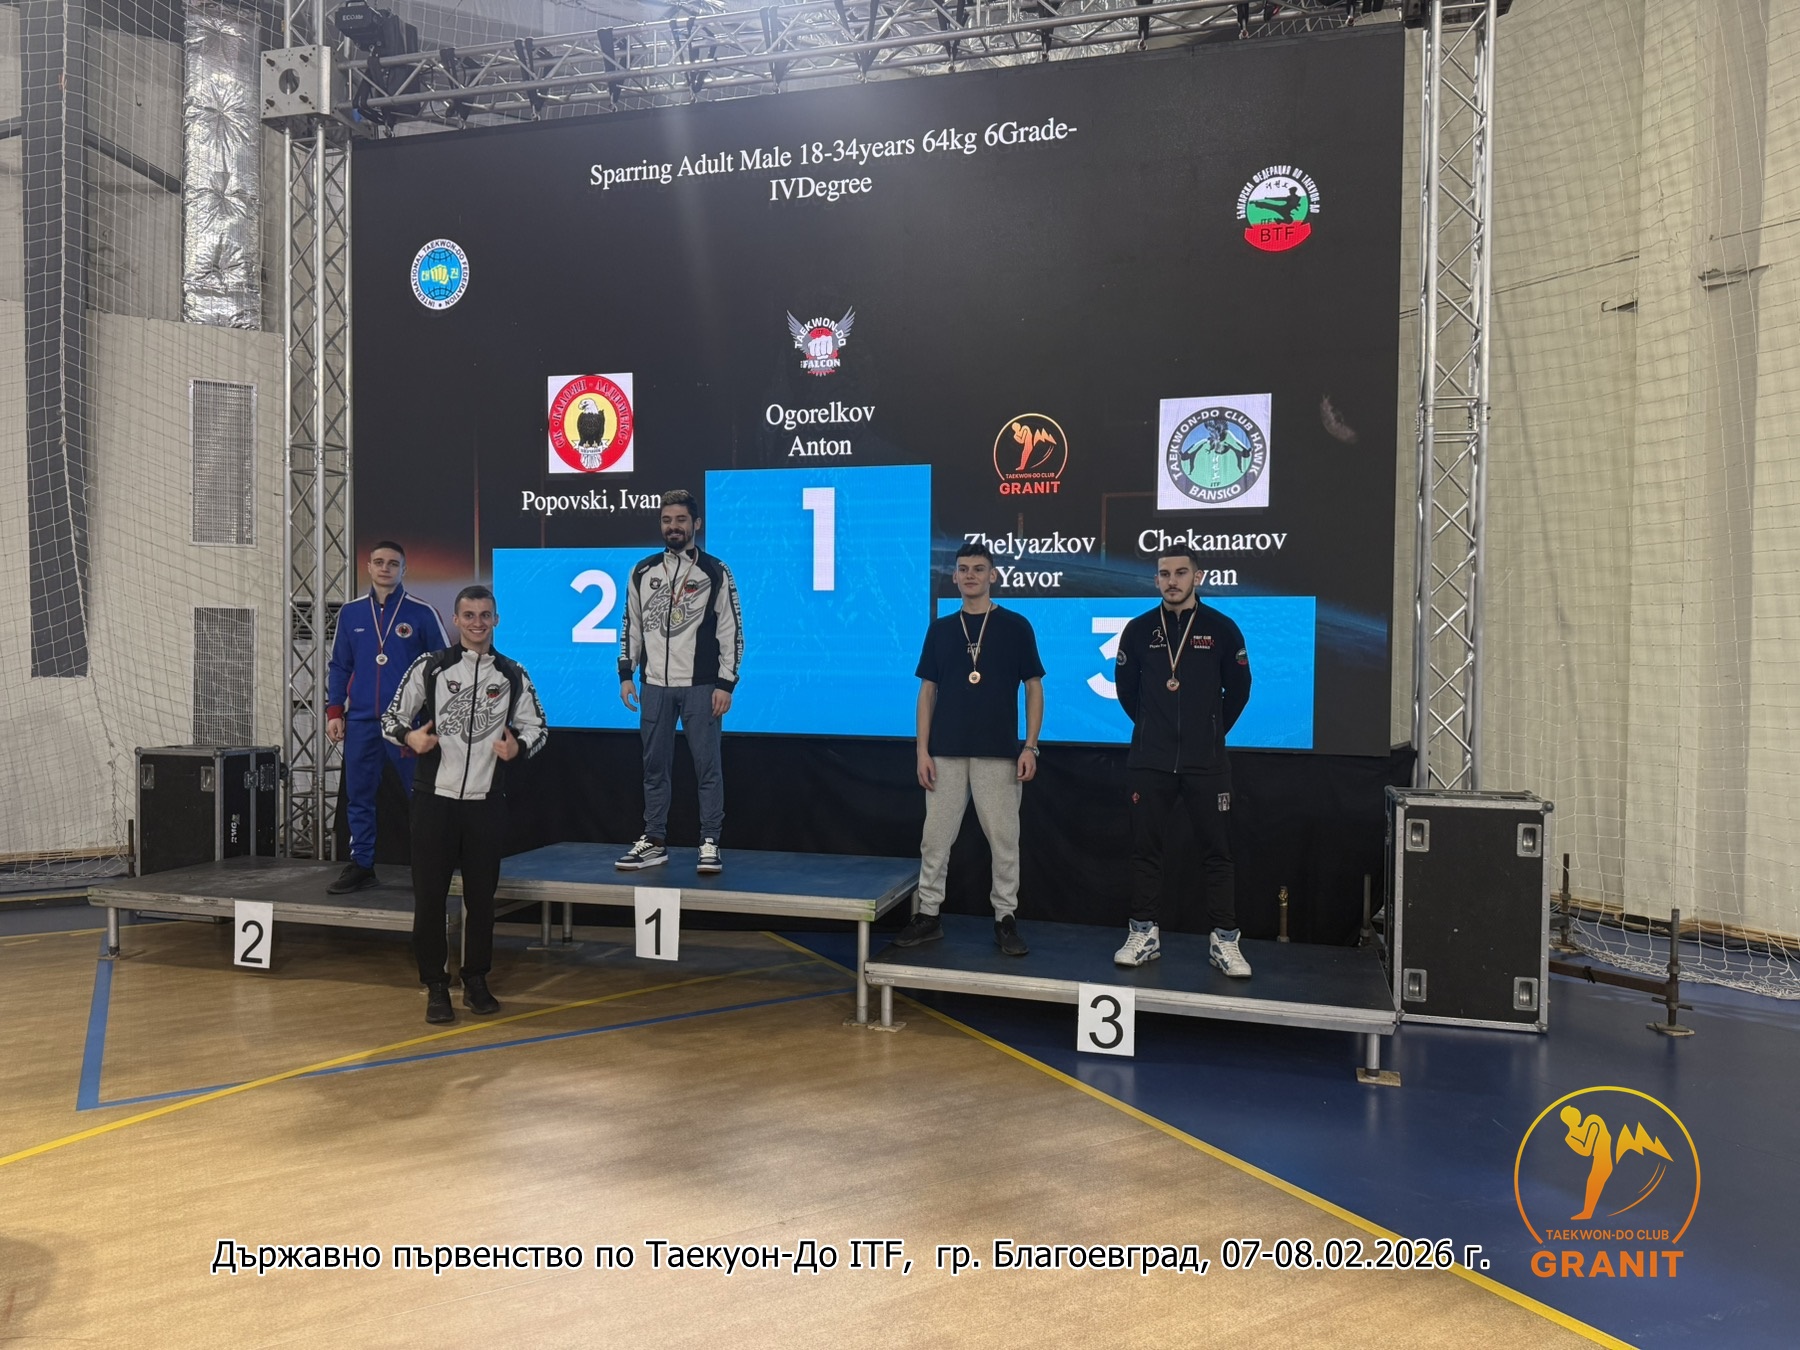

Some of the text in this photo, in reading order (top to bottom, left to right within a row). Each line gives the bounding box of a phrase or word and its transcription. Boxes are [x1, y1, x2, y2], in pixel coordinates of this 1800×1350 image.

[590, 117, 1078, 189] Sparring Adult Male 18-34years 64kg 6Grade-
[1252, 165, 1292, 184] ФЕДЕРАЦИЯ
[1292, 167, 1304, 180] ПО
[769, 175, 873, 202] IVDegree
[1260, 226, 1295, 243] BTF
[411, 240, 469, 308] INTERNATIONAL TAEKWON-DO FEDERATION
[794, 316, 847, 349] TAEKWON-DO
[802, 358, 841, 369] FALCON
[765, 400, 876, 431] Ogorelkov
[787, 435, 853, 458] Anton
[1169, 408, 1265, 481] TAEKWON-DO CLUB HAWK
[999, 480, 1060, 495] GRANIT
[1189, 483, 1241, 501] BANSKO
[521, 489, 662, 516] Popovski, Ivan
[802, 487, 835, 591] 1
[1138, 528, 1288, 553] Chekanarov
[996, 565, 1064, 588] Yavor
[1199, 568, 1238, 587] van
[570, 569, 617, 643] 2
[240, 919, 264, 964] 2
[645, 907, 662, 956] 1
[1088, 994, 1124, 1050] 3
